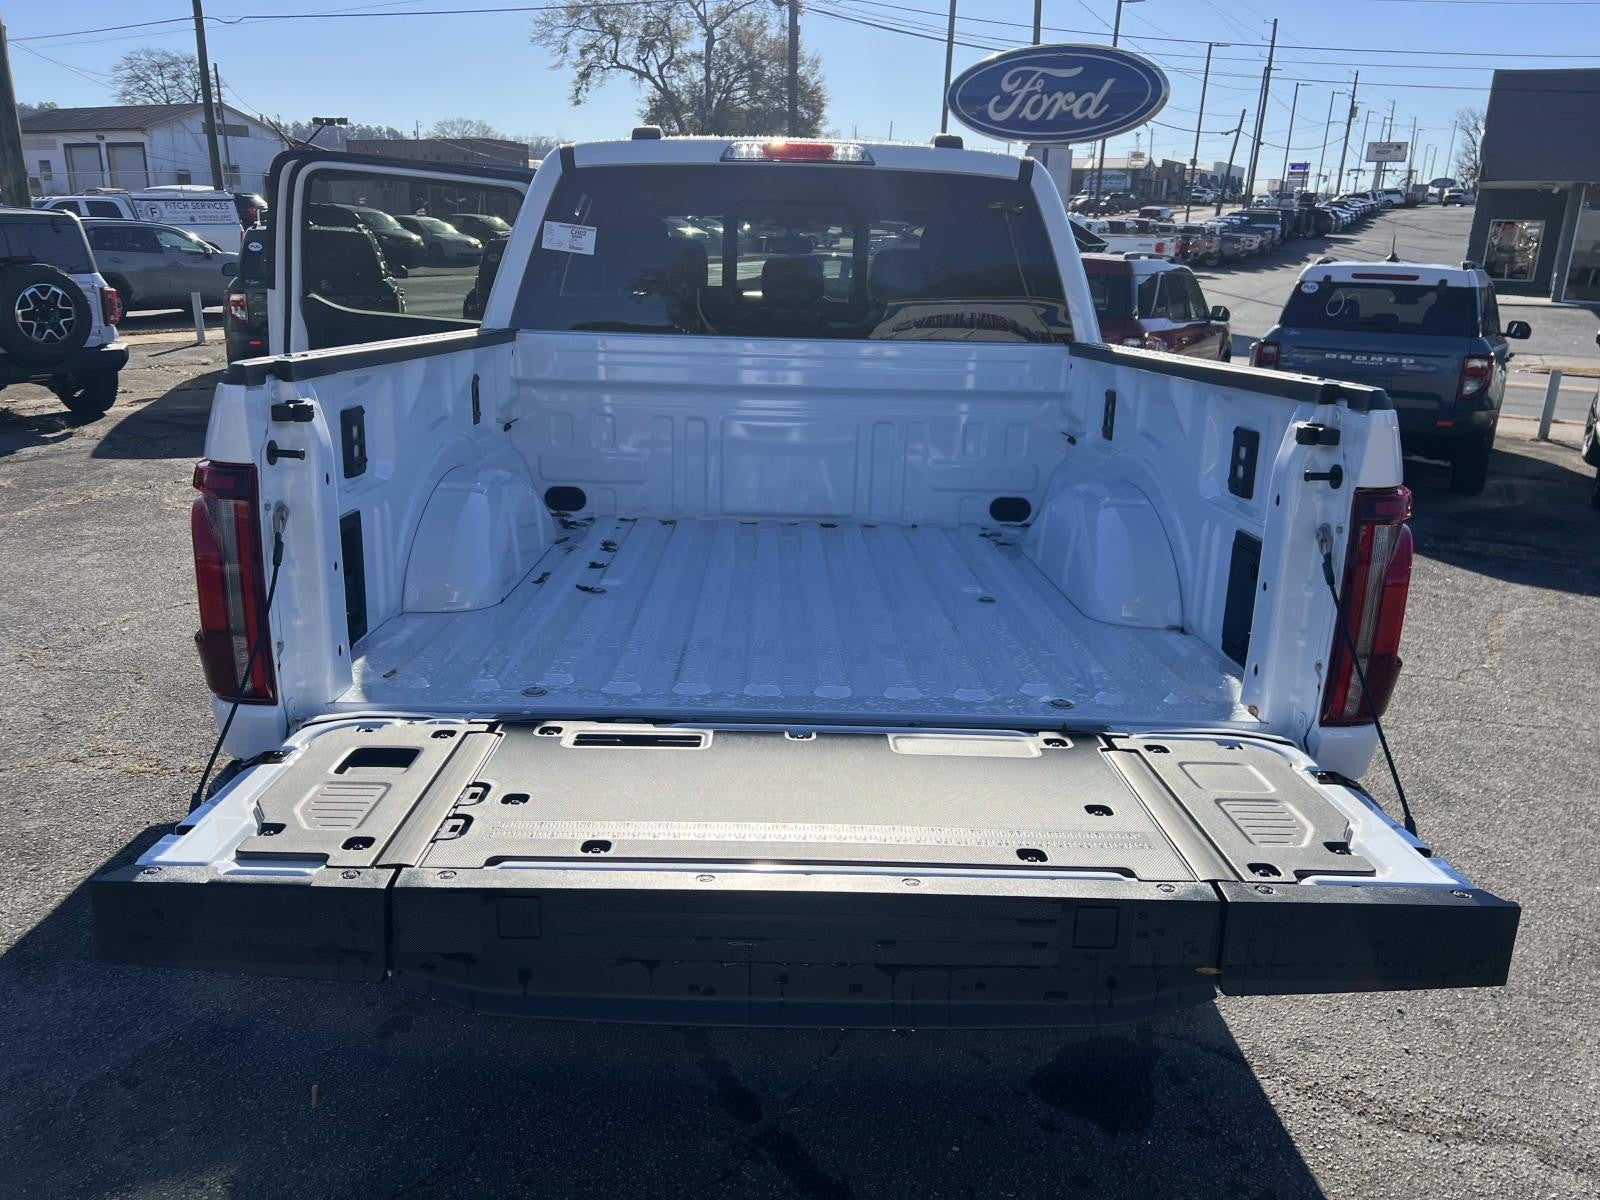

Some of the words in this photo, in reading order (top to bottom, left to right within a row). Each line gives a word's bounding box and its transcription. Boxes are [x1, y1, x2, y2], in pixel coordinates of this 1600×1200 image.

[987, 66, 1116, 121] Ford
[165, 202, 188, 210] FITCH
[192, 202, 229, 210] SERVICES
[150, 207, 158, 218] F
[1325, 353, 1415, 363] BRONCO
